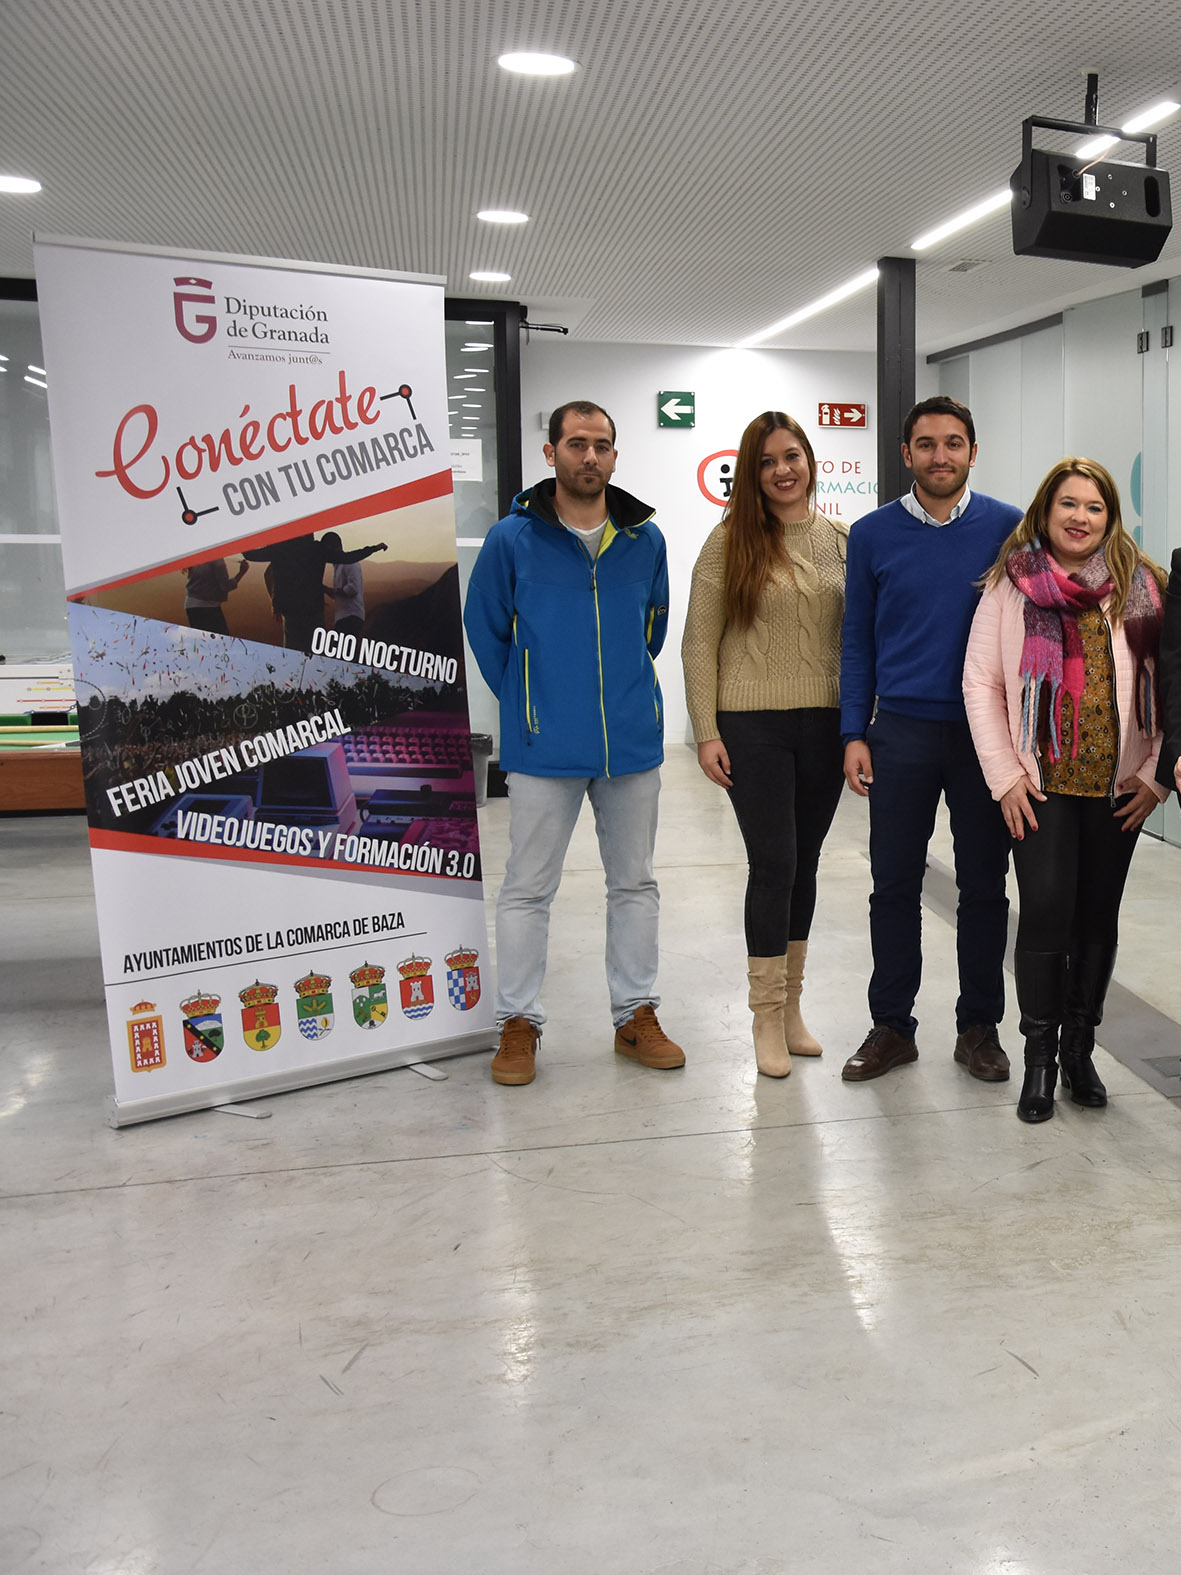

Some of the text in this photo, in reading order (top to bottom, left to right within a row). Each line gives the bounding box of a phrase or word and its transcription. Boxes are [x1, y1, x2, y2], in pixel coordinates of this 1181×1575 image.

[224, 295, 328, 322] Diputación
[226, 321, 330, 344] de Granada
[227, 349, 323, 366] Avanzamos junt@s
[95, 370, 381, 500] Conéctate
[222, 423, 435, 516] CON TU COMARCA
[842, 461, 861, 475] DE
[311, 627, 459, 685] OCIO NOCTURNO
[106, 708, 352, 818] FERIA JOVEN COMARCAL
[177, 810, 476, 880] VIDEOJUEGOS Y FORMACIÓN 3.0
[123, 911, 405, 974] AYUNTAMIENTOS DE LA COMARCA DE BAZA
